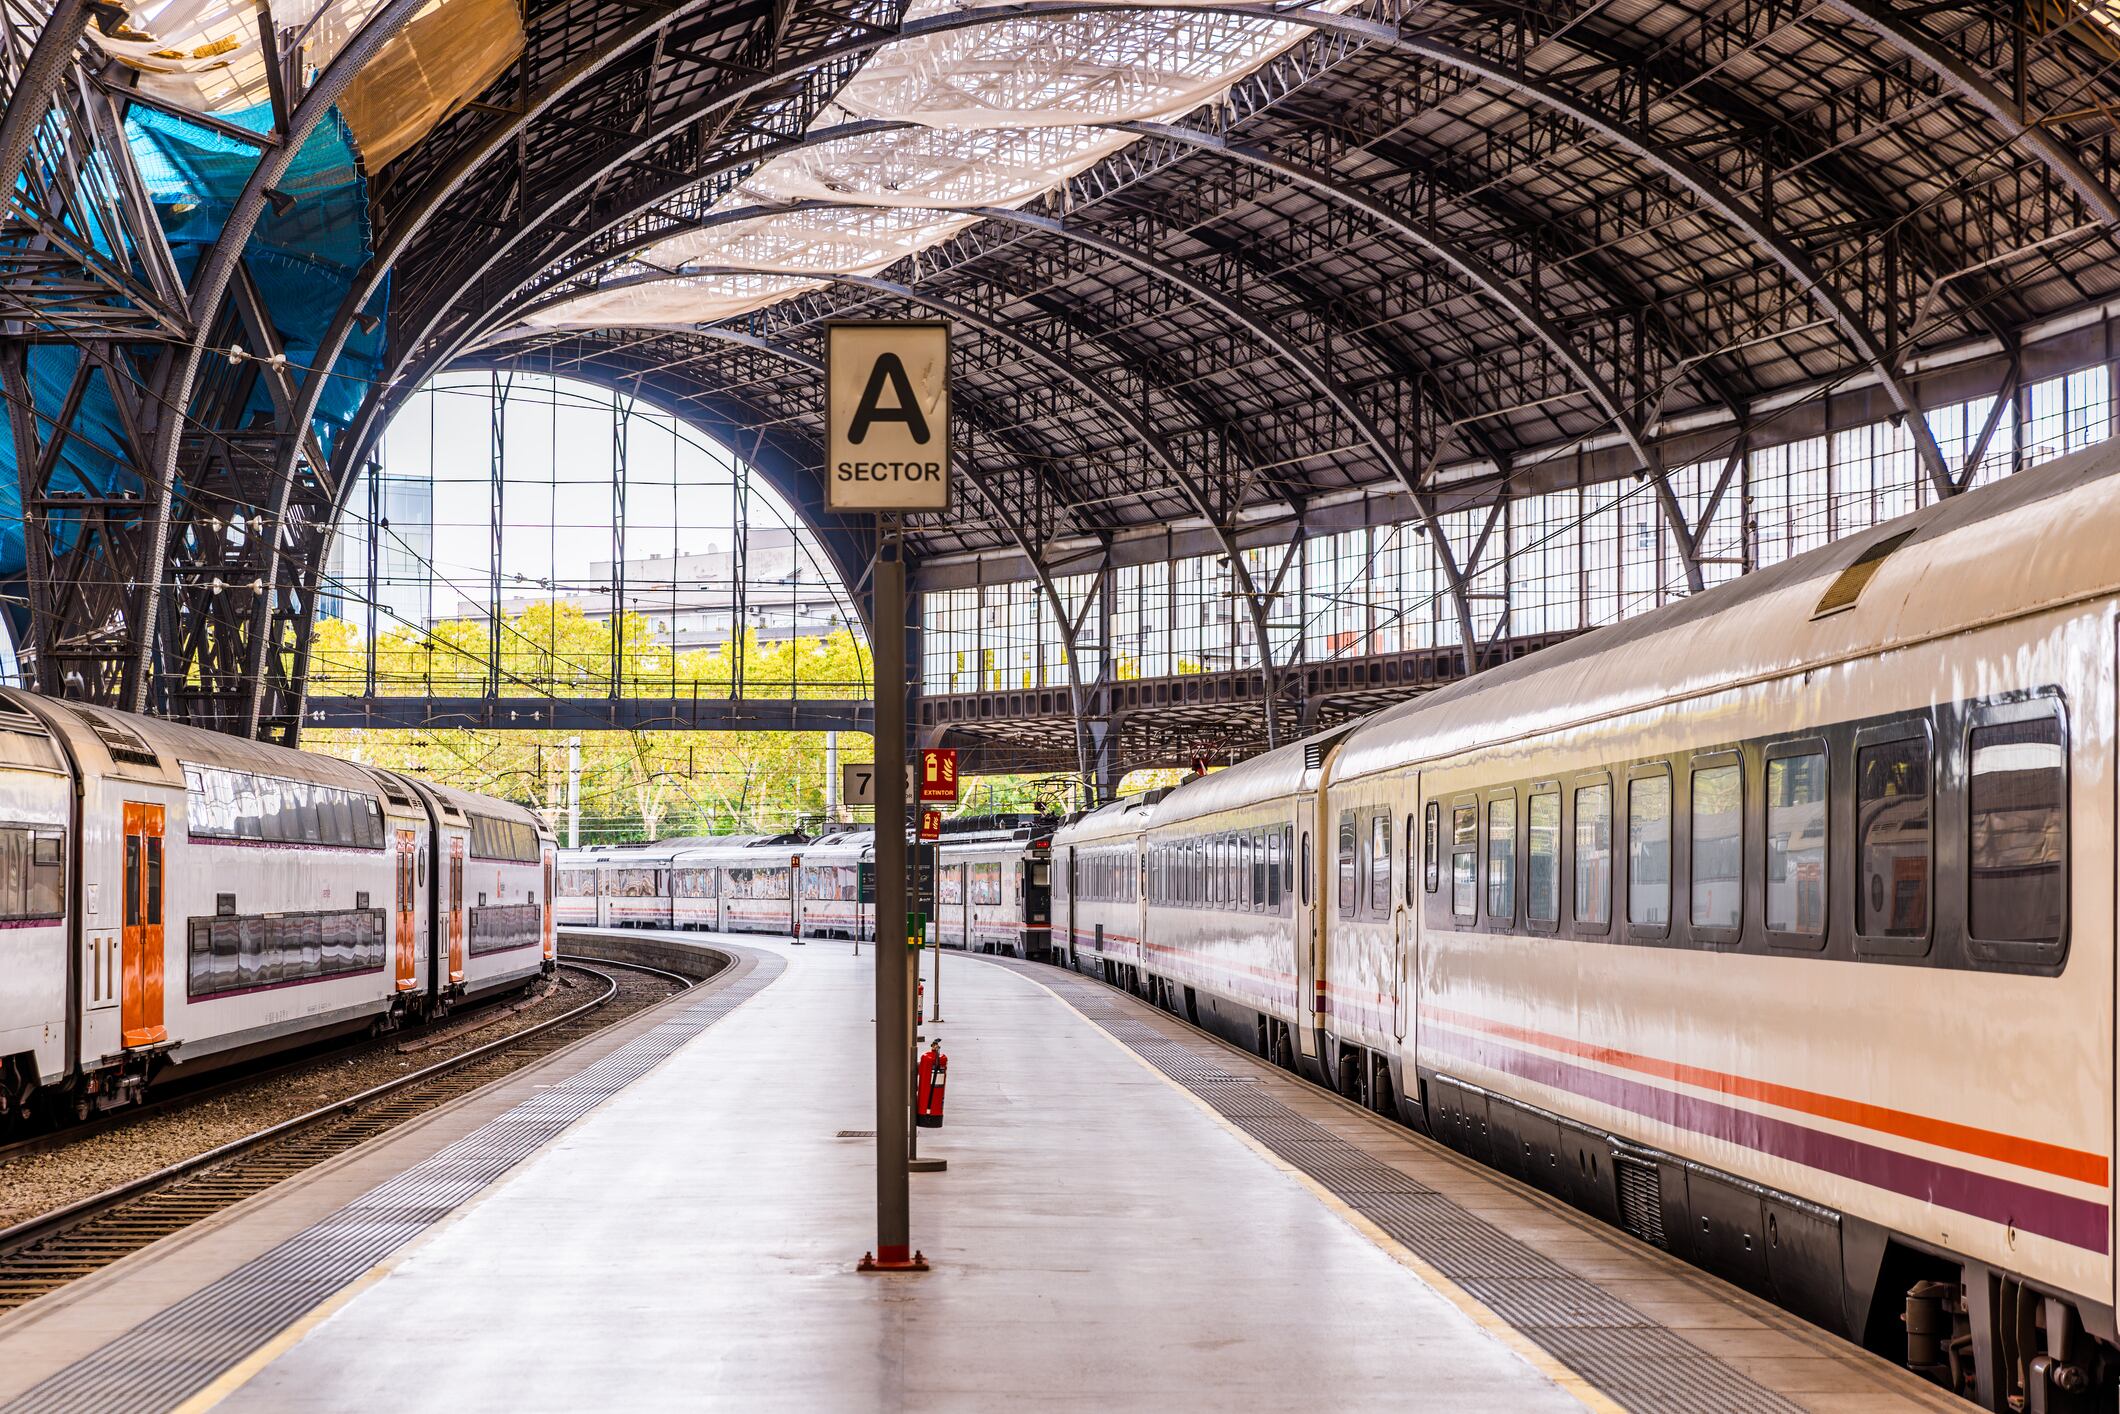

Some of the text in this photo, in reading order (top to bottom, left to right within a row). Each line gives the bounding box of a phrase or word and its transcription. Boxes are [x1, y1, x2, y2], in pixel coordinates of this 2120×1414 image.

[847, 352, 930, 445] A
[838, 462, 941, 482] SECTOR
[856, 773, 871, 795] 7
